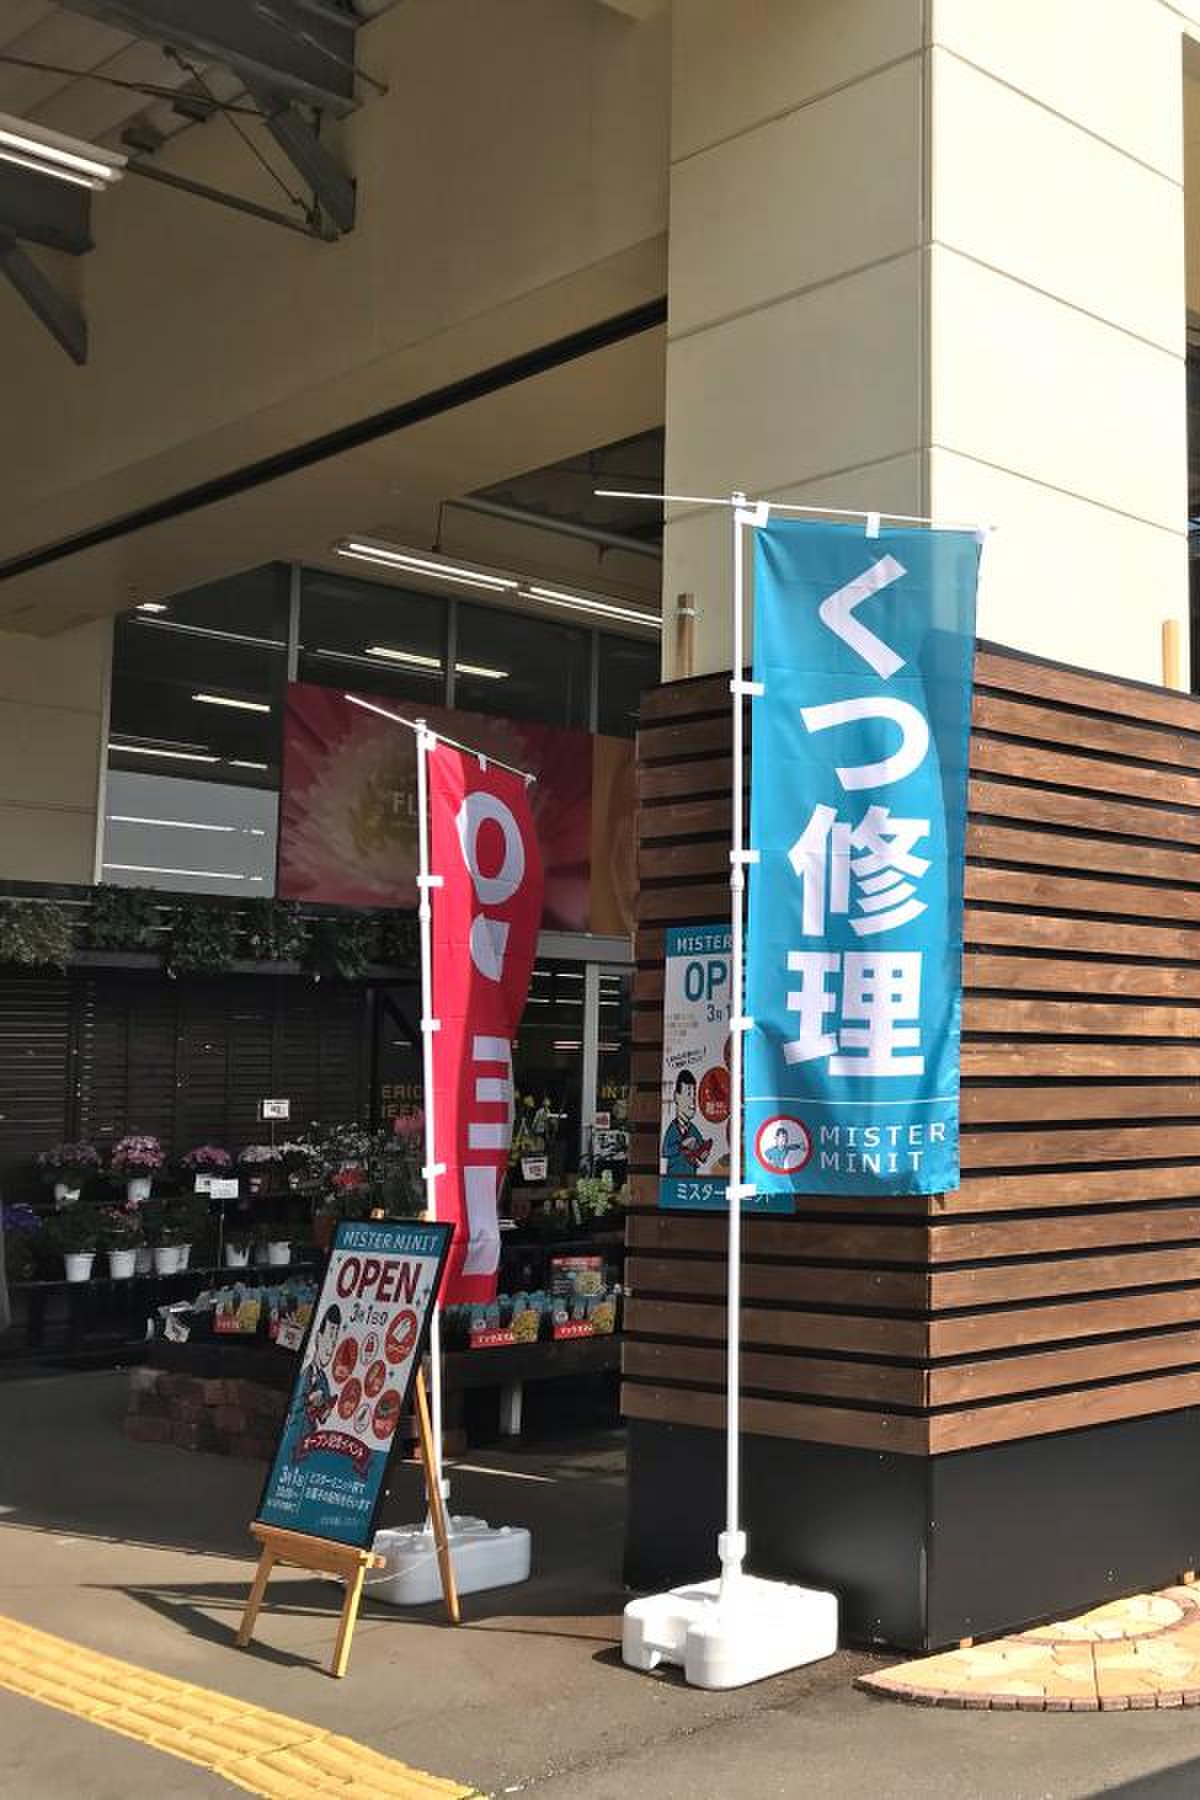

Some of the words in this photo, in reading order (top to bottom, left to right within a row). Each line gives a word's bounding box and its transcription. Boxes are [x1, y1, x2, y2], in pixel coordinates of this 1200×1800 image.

[783, 554, 931, 1077] くつ修理
[677, 933, 733, 952] MISTER
[819, 1121, 946, 1145] MISTER
[819, 1150, 925, 1173] MINIT
[342, 1231, 392, 1249] MISTER
[392, 1234, 438, 1252] MINIT
[336, 1256, 422, 1304] OPEN
